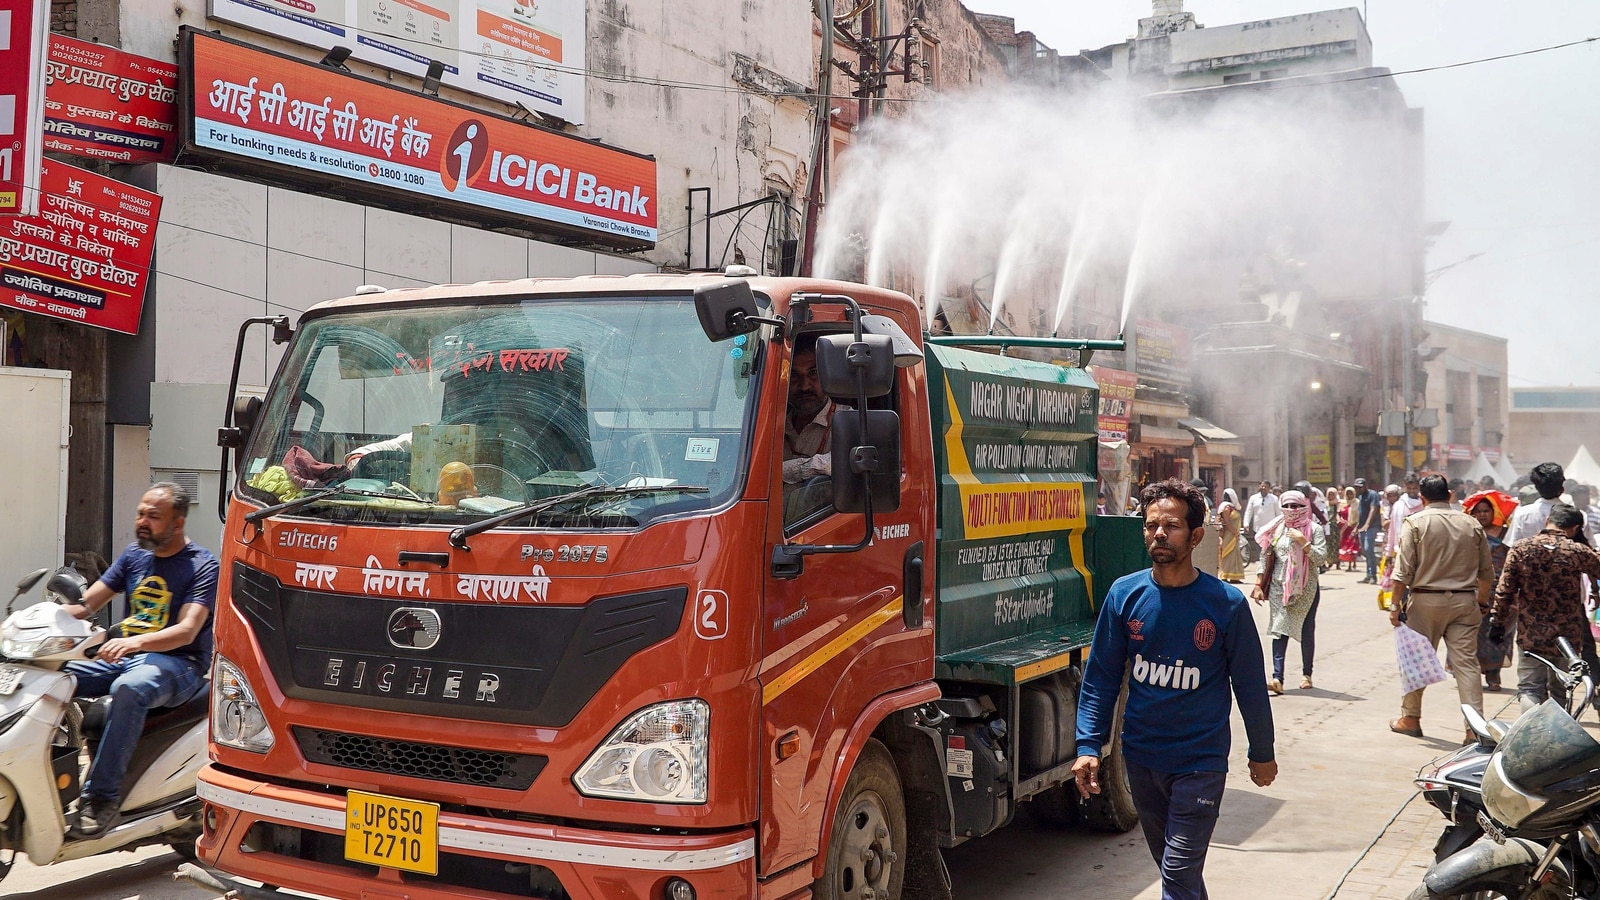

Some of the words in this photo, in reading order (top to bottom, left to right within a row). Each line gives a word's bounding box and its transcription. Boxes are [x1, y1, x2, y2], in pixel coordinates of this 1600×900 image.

[52, 51, 103, 67] 9026293354
[54, 43, 105, 60] 9415343257
[65, 66, 118, 93] प्रसाद
[119, 77, 148, 101] बुक
[149, 79, 178, 104] सेल
[147, 67, 178, 79] 0542-239
[118, 113, 132, 124] के
[136, 115, 174, 132] विक्रेता
[209, 76, 258, 124] आई
[258, 82, 287, 125] सी
[287, 96, 332, 142] आई
[332, 101, 359, 143] सी
[359, 115, 400, 158] आई
[400, 116, 433, 159] बैंक
[94, 131, 160, 149] प्रकाशन
[209, 129, 228, 142] For
[231, 133, 274, 156] banking
[278, 146, 307, 161] needs
[309, 151, 318, 162] &
[319, 154, 366, 173] resolution
[379, 166, 401, 181] 1800
[403, 172, 425, 186] 1080
[488, 150, 571, 199] ICICI
[574, 170, 650, 218] Bank
[121, 192, 152, 207] 9415343257
[42, 209, 86, 230] ज्योतिष
[88, 224, 99, 236] व
[102, 227, 140, 248] धार्मिक
[99, 210, 149, 233] कर्मकाण्ड
[582, 215, 610, 229] Varanasi
[610, 221, 630, 234] Chowk
[630, 226, 651, 238] Branch
[59, 229, 74, 247] के
[76, 234, 114, 259] विक्रेता
[21, 243, 70, 272] प्रसाद
[70, 255, 100, 279] बुक
[100, 258, 139, 288] सेलर
[4, 273, 54, 294] ज्योतिष
[54, 285, 103, 306] प्रकाशन
[47, 302, 87, 319] वाराणसी
[499, 347, 571, 373] सरकार
[971, 381, 1003, 420] NAGAR
[1006, 385, 1036, 425] NIGAM,
[1037, 389, 1077, 425] VARANASI
[975, 444, 988, 469] AIR
[988, 444, 1022, 469] POLLUTION
[1022, 445, 1047, 469] CONTROL
[1048, 445, 1078, 471] EQUIPMENT
[967, 493, 992, 528] MULTI
[992, 492, 1027, 525] FUNCTION
[1028, 490, 1048, 522] WATER
[1048, 488, 1081, 520] SPRINKLER
[882, 524, 910, 540] EICHER
[521, 544, 554, 562] Pro
[557, 545, 608, 563] 2075
[957, 546, 986, 566] FUNDED
[988, 545, 998, 561] BY
[998, 543, 1014, 560] 15TH
[1014, 540, 1040, 559] FINANCE
[982, 561, 1005, 581] UNDER
[1022, 555, 1049, 576] PROJECT
[294, 562, 338, 591] नगर
[456, 564, 552, 604] वाराणसी
[702, 595, 718, 631] 2
[324, 658, 500, 702] EICHER
[1132, 654, 1200, 690] bwin
[364, 802, 423, 835] UP65Q
[363, 830, 421, 863] T2710
